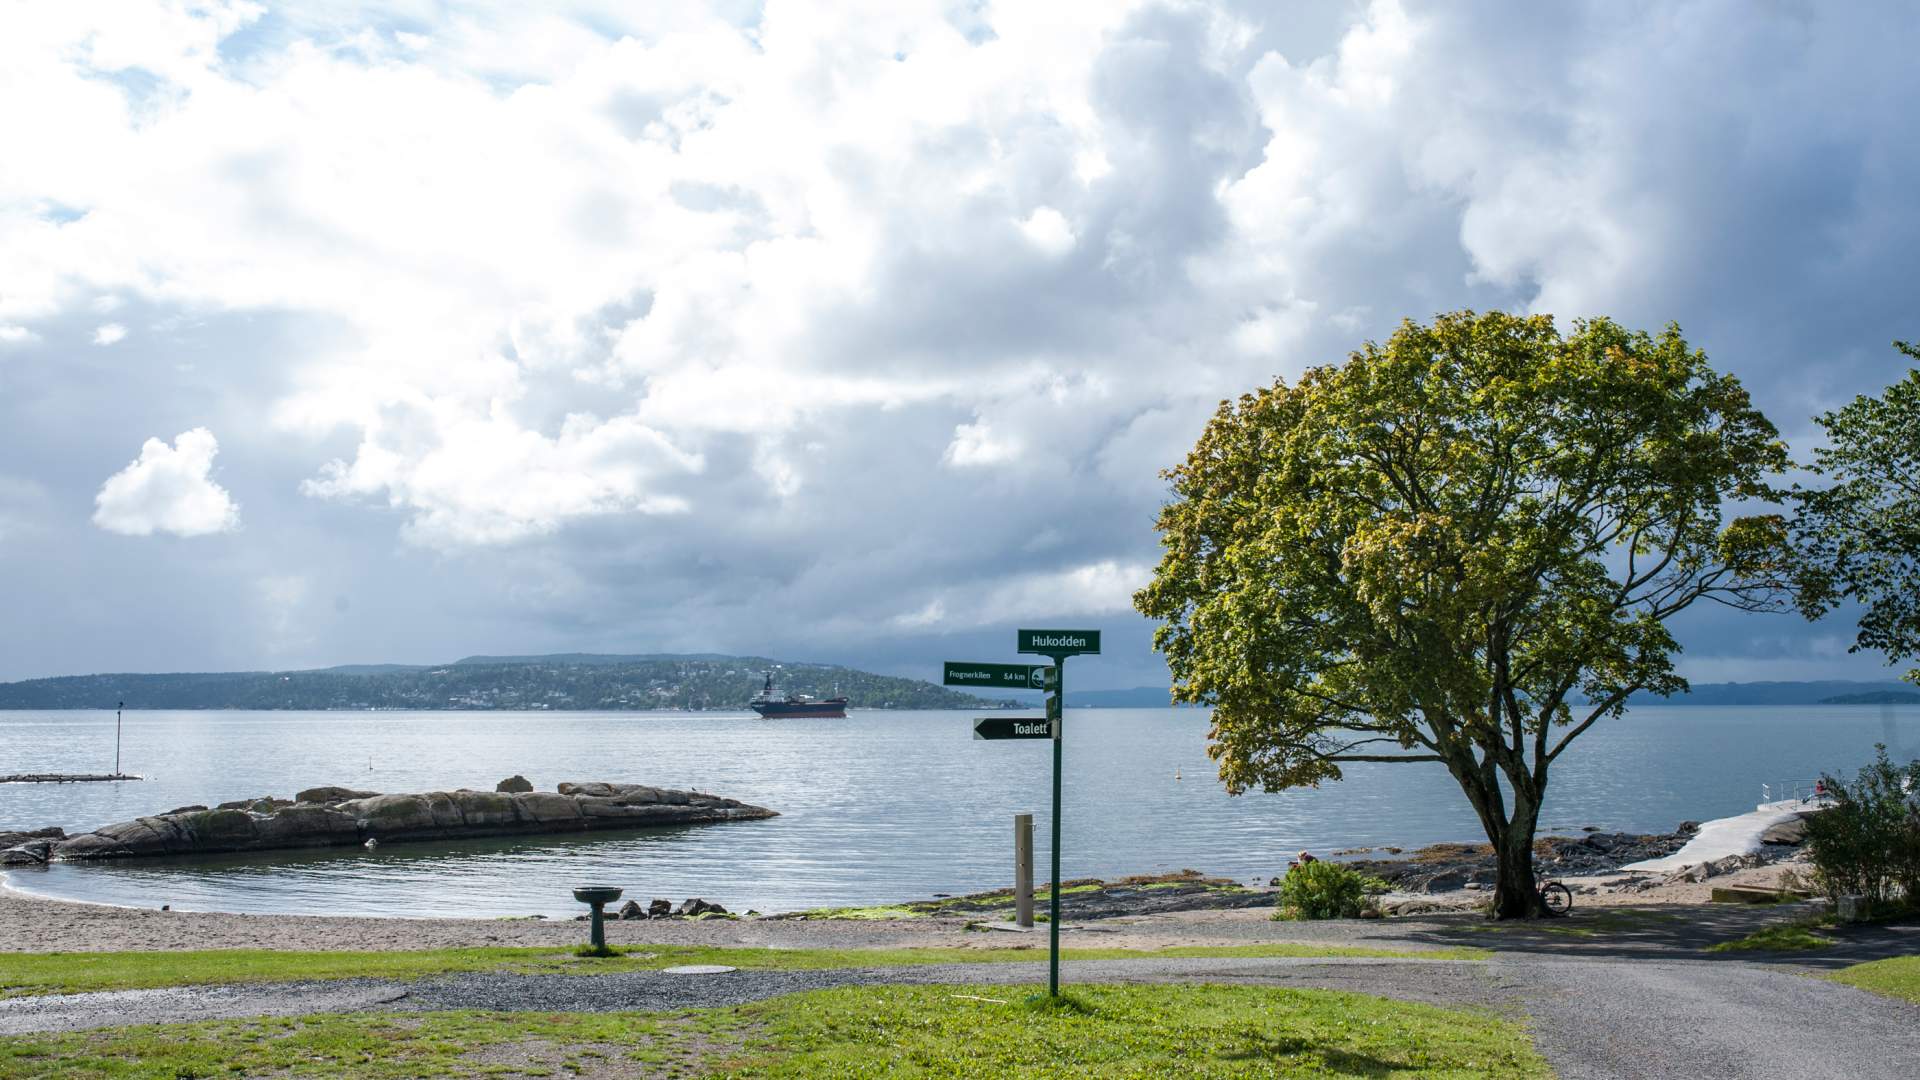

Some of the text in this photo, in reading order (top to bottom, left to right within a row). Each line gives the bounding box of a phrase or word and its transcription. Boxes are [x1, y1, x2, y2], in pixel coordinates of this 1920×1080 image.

[1032, 635, 1086, 647] Hukodden
[949, 670, 991, 679] Frognerkilen
[1014, 672, 1026, 680] km
[1013, 723, 1048, 735] Toalett
